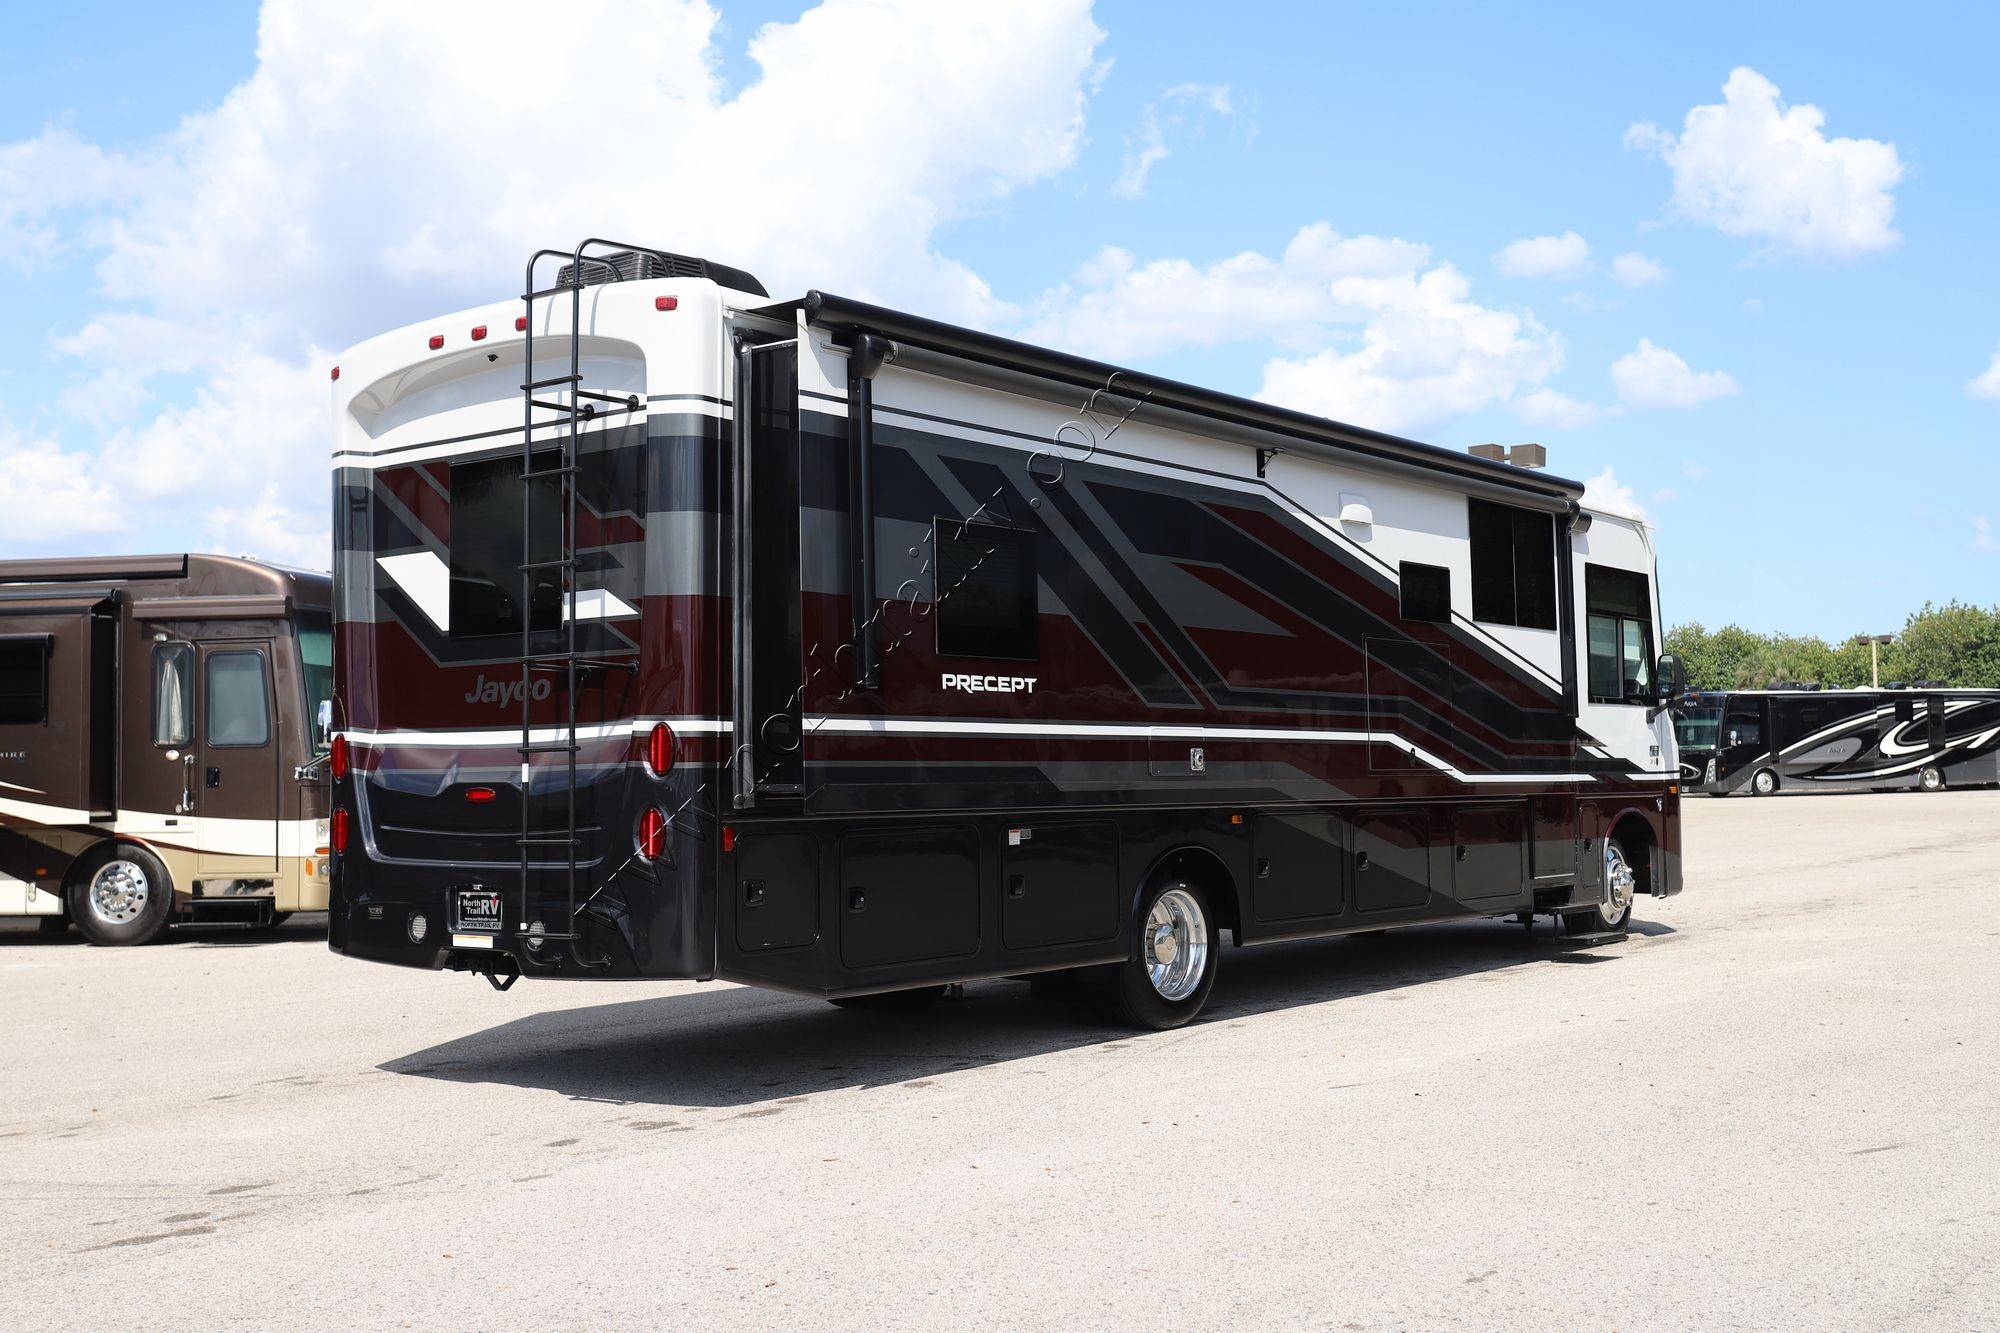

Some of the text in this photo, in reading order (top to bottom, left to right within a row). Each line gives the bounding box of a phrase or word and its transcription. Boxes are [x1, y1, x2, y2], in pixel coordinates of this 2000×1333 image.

[464, 674, 552, 709] Jayco
[941, 673, 1038, 694] PRECEPT
[462, 899, 480, 907] North
[466, 907, 480, 915] Trail
[481, 899, 499, 915] RV
